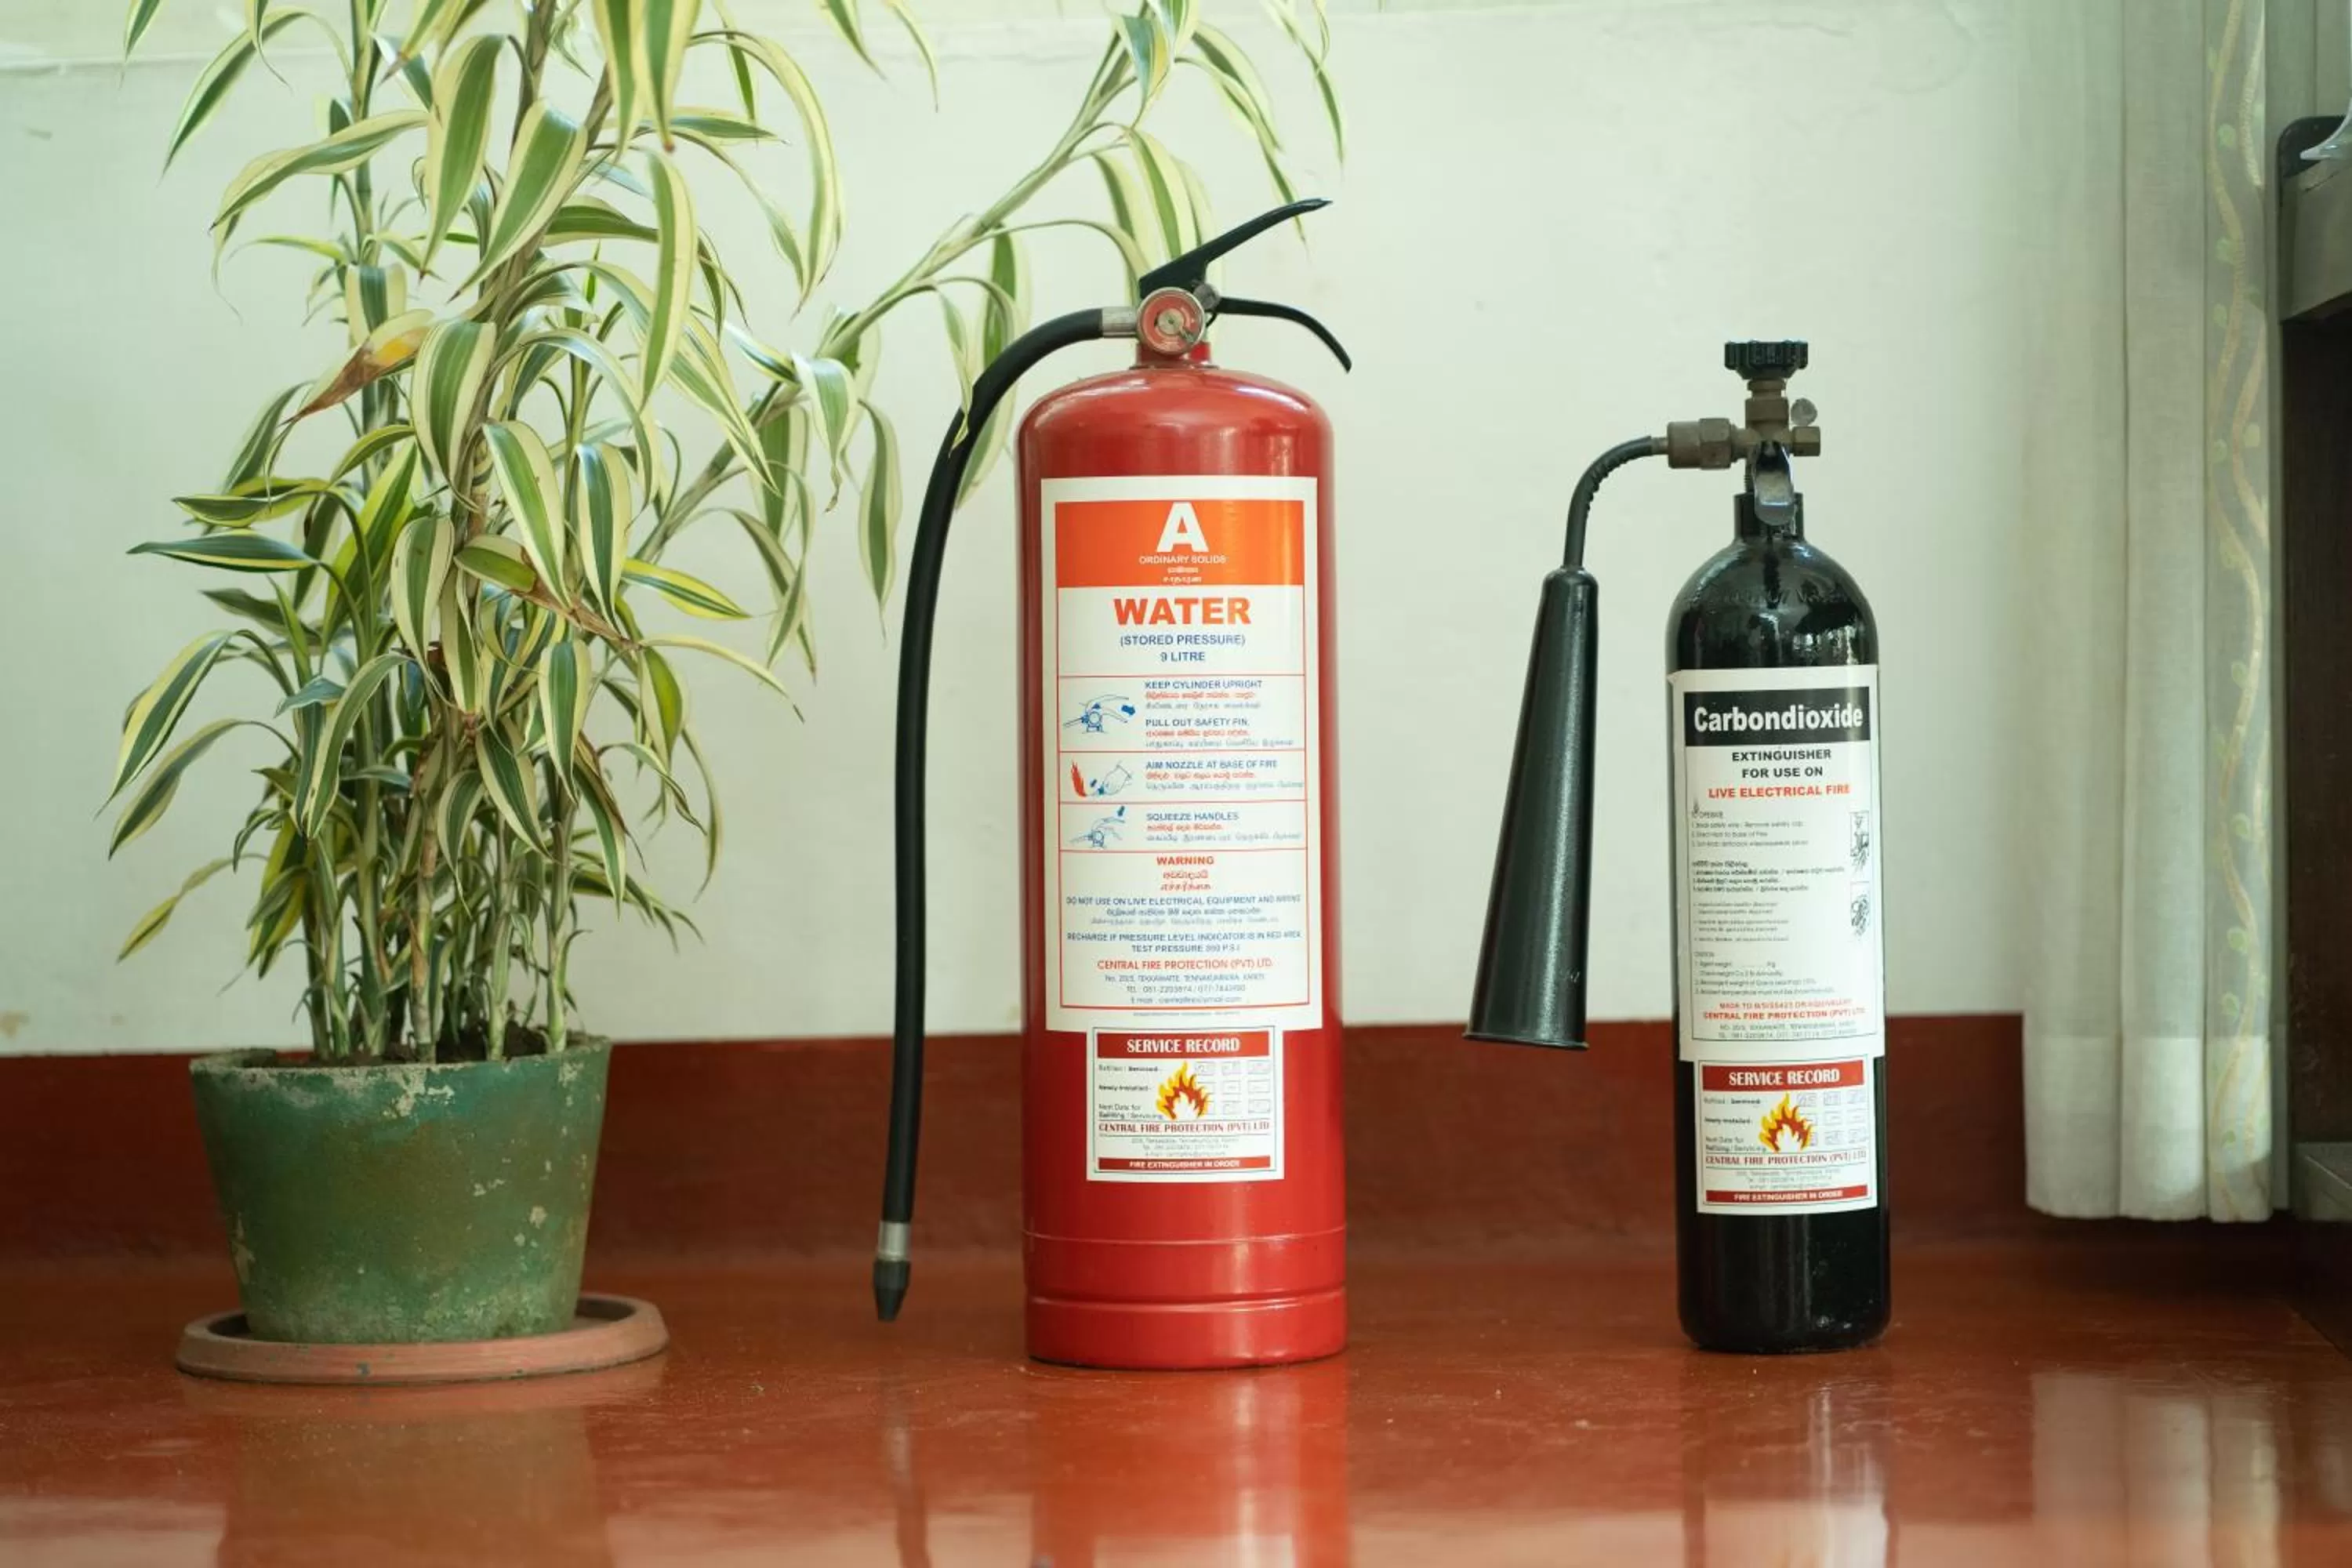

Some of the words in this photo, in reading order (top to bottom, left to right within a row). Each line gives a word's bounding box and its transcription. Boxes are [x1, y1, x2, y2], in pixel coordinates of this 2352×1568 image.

[1156, 502, 1210, 552] A
[1138, 555, 1189, 564] ORDINARY
[1192, 555, 1227, 564] SOLIDS
[1113, 598, 1251, 625] WATER
[1120, 634, 1174, 647] (STORED
[1178, 634, 1246, 646] PRESSURE)
[1160, 652, 1167, 662] 9
[1171, 652, 1206, 661] LITRE
[1145, 680, 1171, 689] KEEP
[1172, 680, 1221, 689] CYLINDER
[1222, 680, 1262, 688] UPRIGHT
[1145, 718, 1171, 728] PULL
[1172, 718, 1192, 728] OUT
[1194, 717, 1230, 727] SAFETY
[1694, 703, 1864, 731] Carbondioxide
[1732, 749, 1831, 762] EXTINGUISHER
[1145, 760, 1163, 770] AIM
[1166, 760, 1203, 769] NOZZLE
[1207, 760, 1217, 769] AT
[1219, 760, 1243, 769] BASE
[1246, 759, 1257, 768] OF
[1742, 768, 1769, 779] FOR
[1773, 767, 1800, 778] USE
[1805, 766, 1823, 777] ON
[1708, 788, 1735, 799] LIVE
[1740, 786, 1821, 797] ELECTRICAL
[1826, 784, 1850, 795] FIRE
[1145, 812, 1192, 822] SQUEEZE
[1194, 811, 1240, 821] HANDLES
[1156, 855, 1214, 866] WARNING
[1095, 897, 1112, 906] USE
[1112, 897, 1127, 906] ON
[1127, 897, 1148, 906] LIVE
[1149, 896, 1204, 906] ELECTRICAL
[1207, 896, 1256, 905] EQUIPMENT
[1066, 932, 1108, 942] RECHARGE
[1119, 932, 1167, 942] PRESSURE
[1167, 932, 1195, 942] LEVEL
[1198, 932, 1246, 942] INDICATOR
[1257, 931, 1265, 940] IN
[1131, 944, 1152, 953] TEST
[1155, 944, 1203, 953] PRESSURE
[1097, 960, 1139, 970] CENTRAL
[1142, 960, 1161, 970] FIRE
[1164, 959, 1229, 970] PROTECTION
[1230, 958, 1255, 969] (PVT)
[1704, 1011, 1741, 1020] CENTRAL
[1744, 1011, 1763, 1020] FIRE
[1768, 1010, 1828, 1020] PROTECTION
[1127, 1039, 1182, 1053] SERVICE
[1185, 1038, 1240, 1052] RECORD
[1729, 1071, 1784, 1086] SERVICE
[1787, 1069, 1840, 1084] RECORD
[1098, 1123, 1137, 1132] CENTRAL
[1141, 1123, 1160, 1132] FIRE
[1164, 1123, 1224, 1132] PROTECTION
[1768, 1156, 1828, 1164] PROTECTION
[1752, 1192, 1807, 1201] EXTINGUISHER
